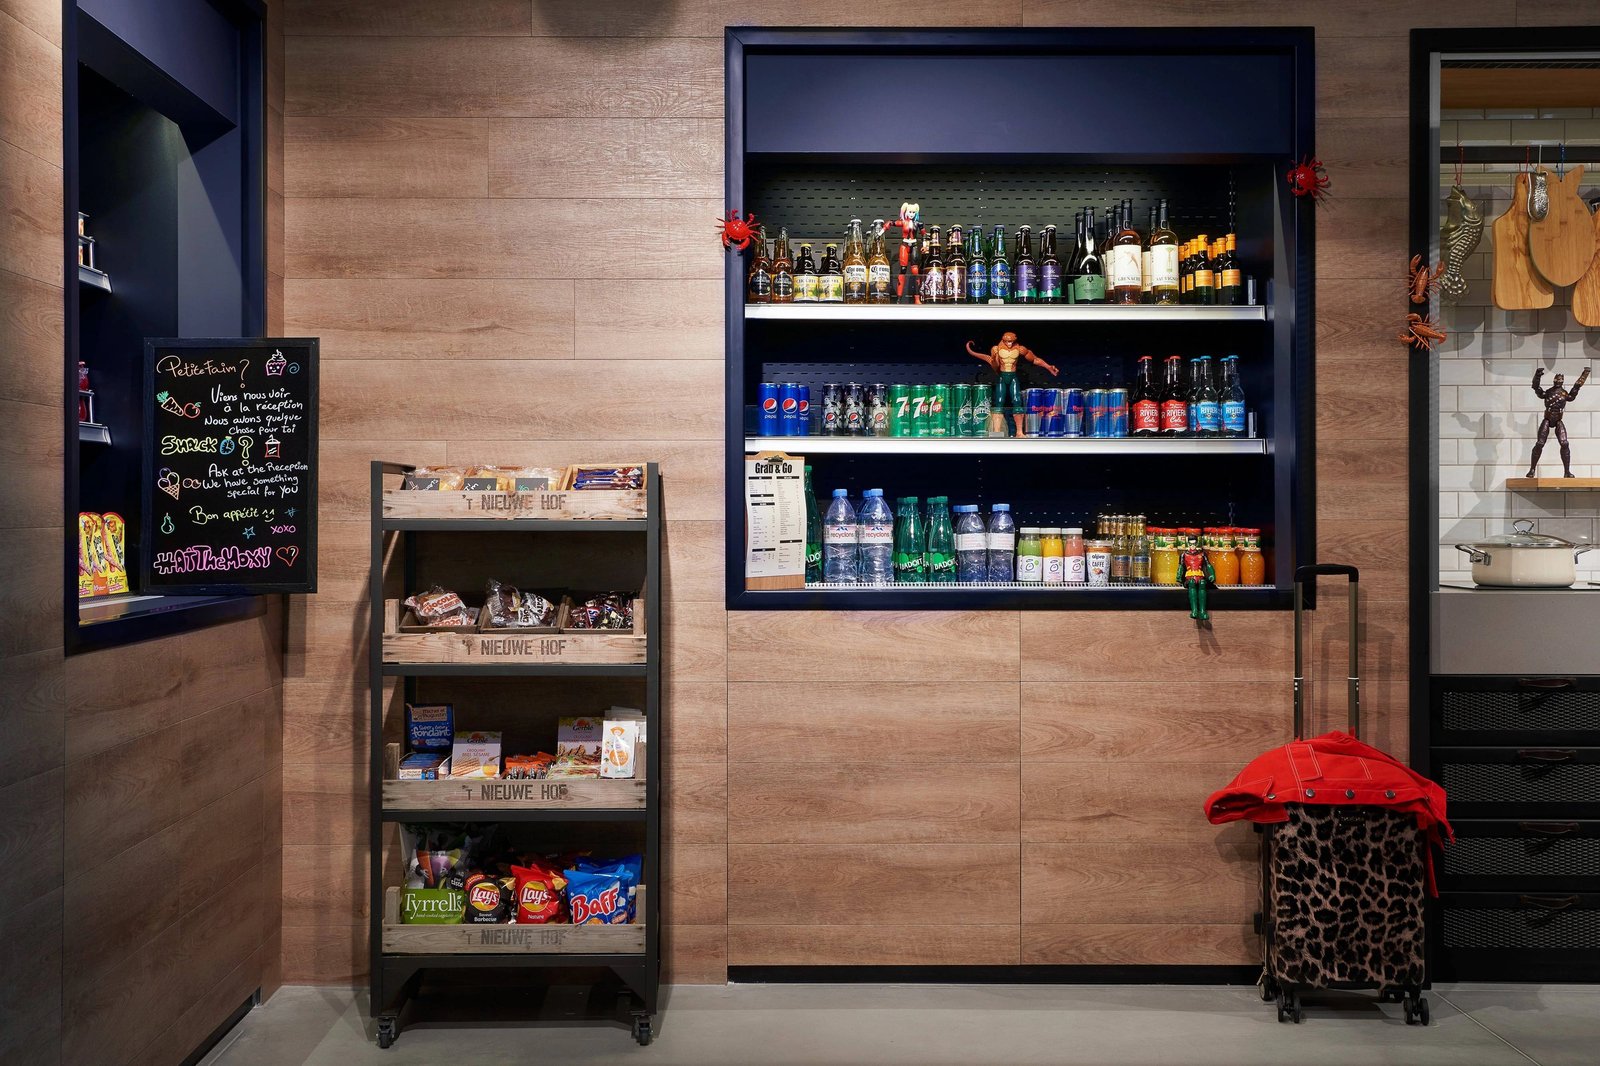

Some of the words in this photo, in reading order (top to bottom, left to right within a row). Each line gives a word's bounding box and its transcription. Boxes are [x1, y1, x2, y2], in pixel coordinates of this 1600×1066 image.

[203, 359, 237, 376] Faim
[211, 384, 238, 404] Viens
[243, 391, 267, 400] nous
[223, 401, 233, 413] à
[240, 400, 251, 413] la
[256, 396, 304, 412] réception
[204, 416, 230, 427] Nous
[233, 415, 262, 425] avons
[266, 410, 303, 427] quelque
[259, 426, 279, 437] pour
[281, 423, 297, 434] toi
[231, 466, 246, 477] at
[248, 461, 266, 476] the
[267, 461, 310, 474] Reception
[782, 463, 793, 474] Go
[203, 478, 222, 490] We
[224, 475, 250, 487] have
[253, 474, 299, 489] something
[226, 487, 260, 500] special
[264, 486, 276, 497] for
[481, 495, 533, 511] NIEUWE
[541, 495, 568, 511] HOF
[189, 505, 219, 526] Bon
[223, 508, 260, 524] appétit
[865, 531, 890, 540] recyclons
[481, 640, 533, 656] NIEUWE
[541, 640, 568, 656] HOF
[412, 726, 452, 738] fondant
[481, 784, 533, 801] NIEUWE
[541, 784, 568, 801] HOF
[472, 887, 499, 905] Lay's
[404, 892, 463, 919] Tyrrell's
[569, 887, 620, 924] Baff
